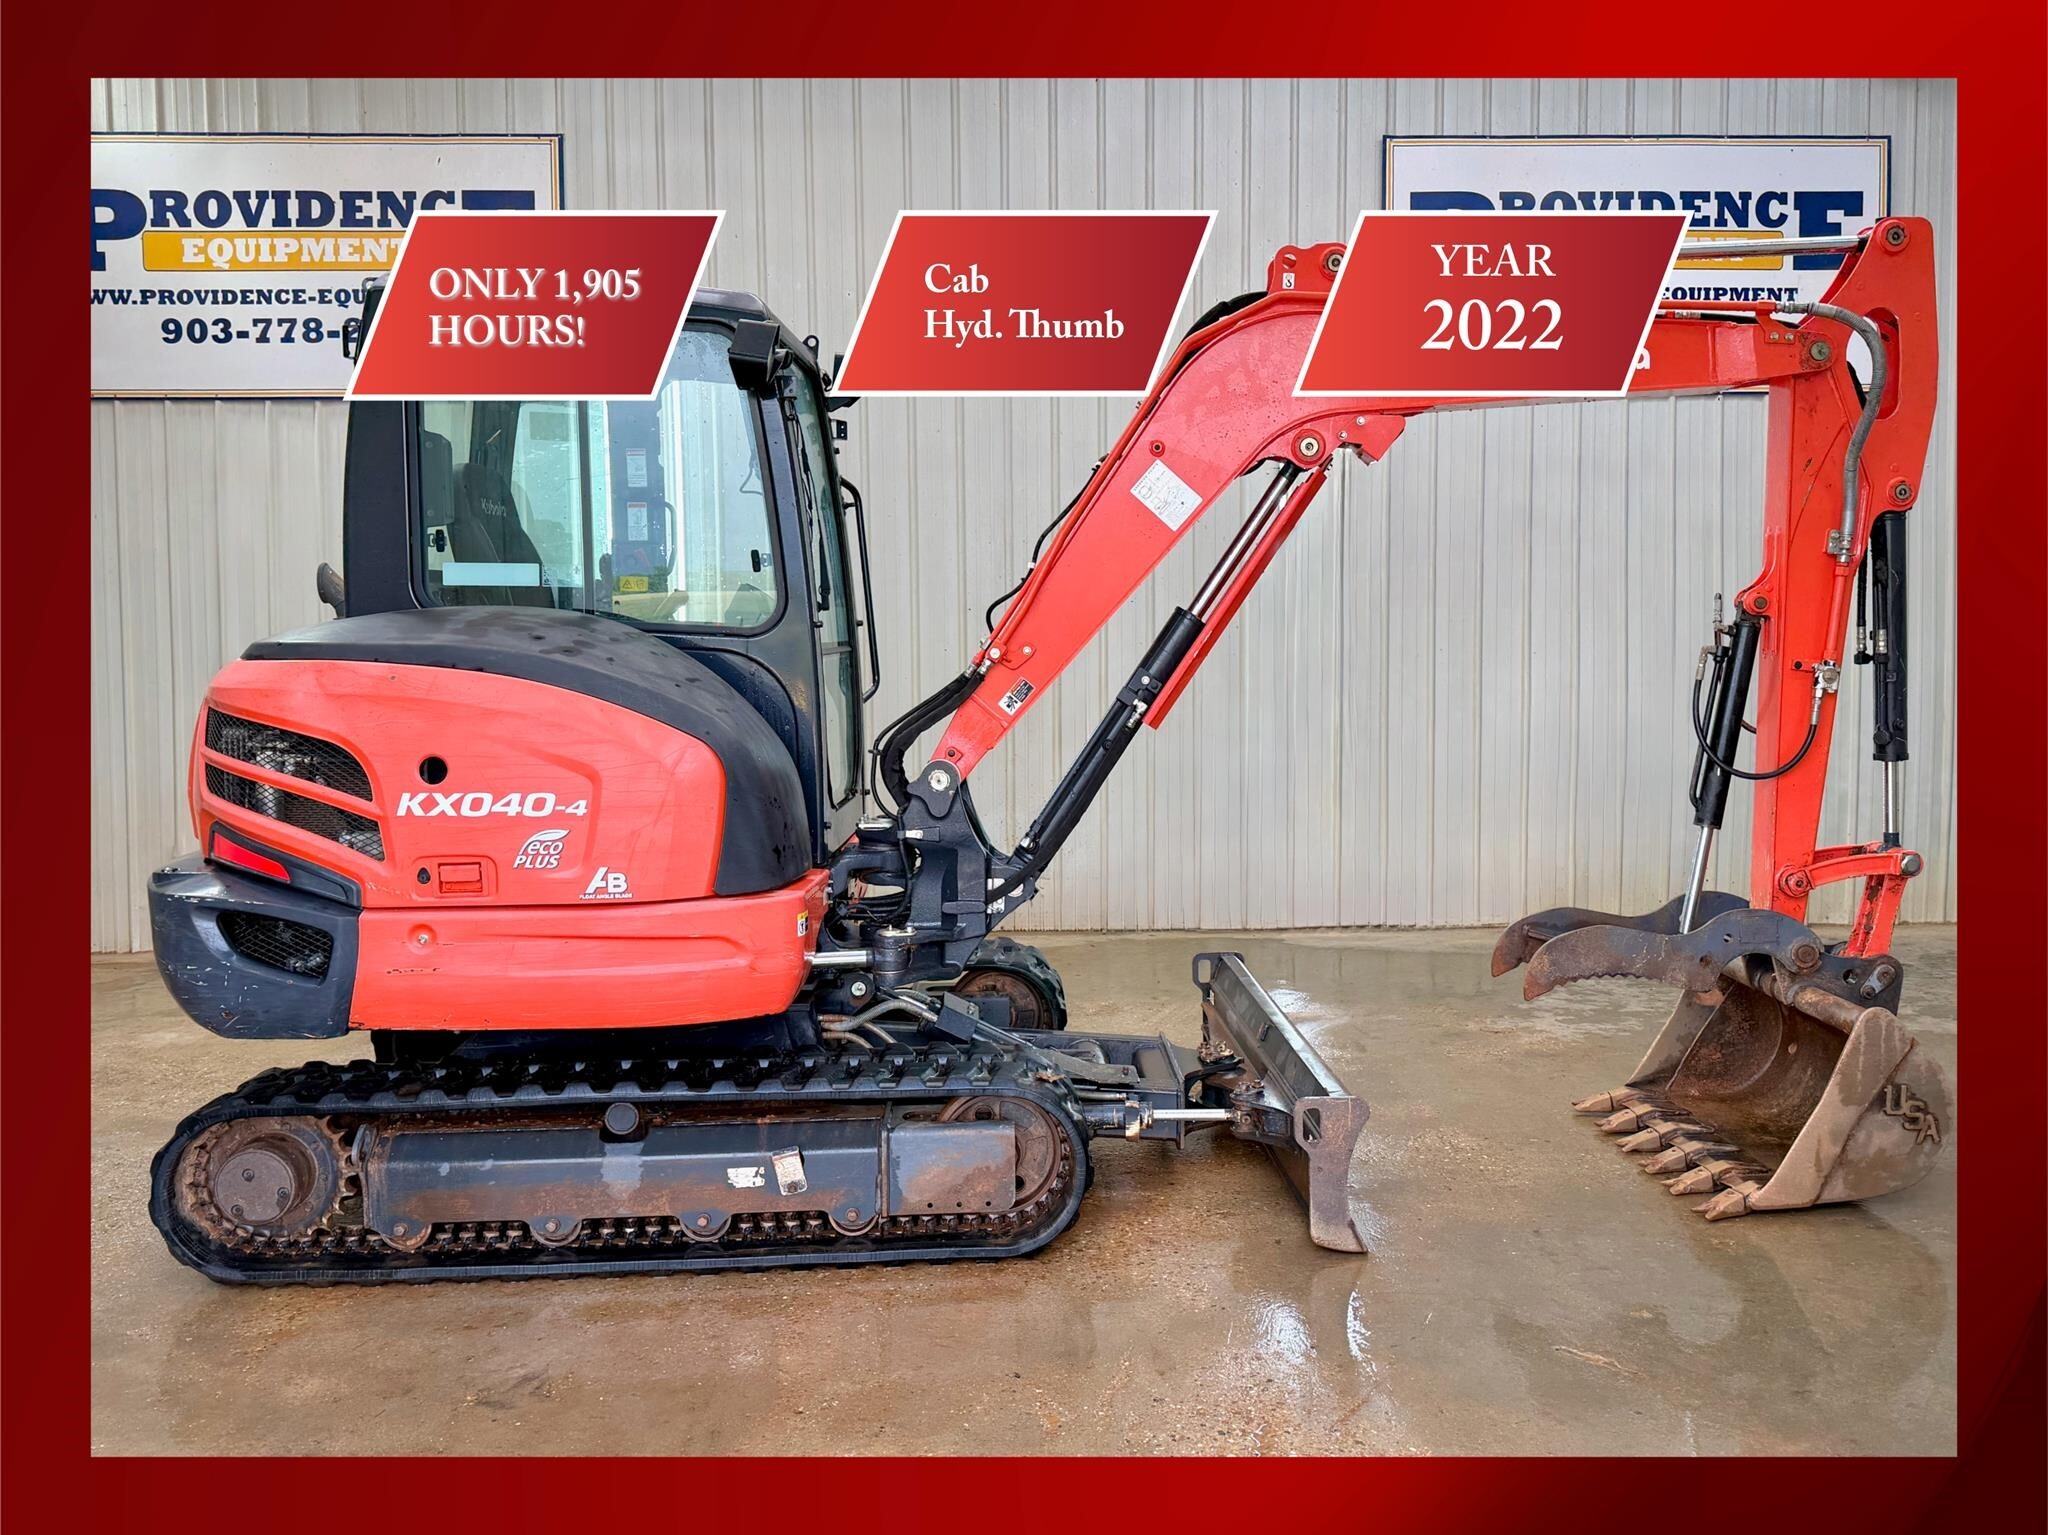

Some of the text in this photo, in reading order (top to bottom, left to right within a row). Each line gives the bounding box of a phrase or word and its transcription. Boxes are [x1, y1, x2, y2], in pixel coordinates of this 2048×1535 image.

[1410, 190, 1863, 270] ROVIDENCE
[396, 792, 589, 818] KX040-4
[527, 841, 563, 855] eco
[512, 855, 560, 869] PLUS
[1882, 1084, 1941, 1145] USA
